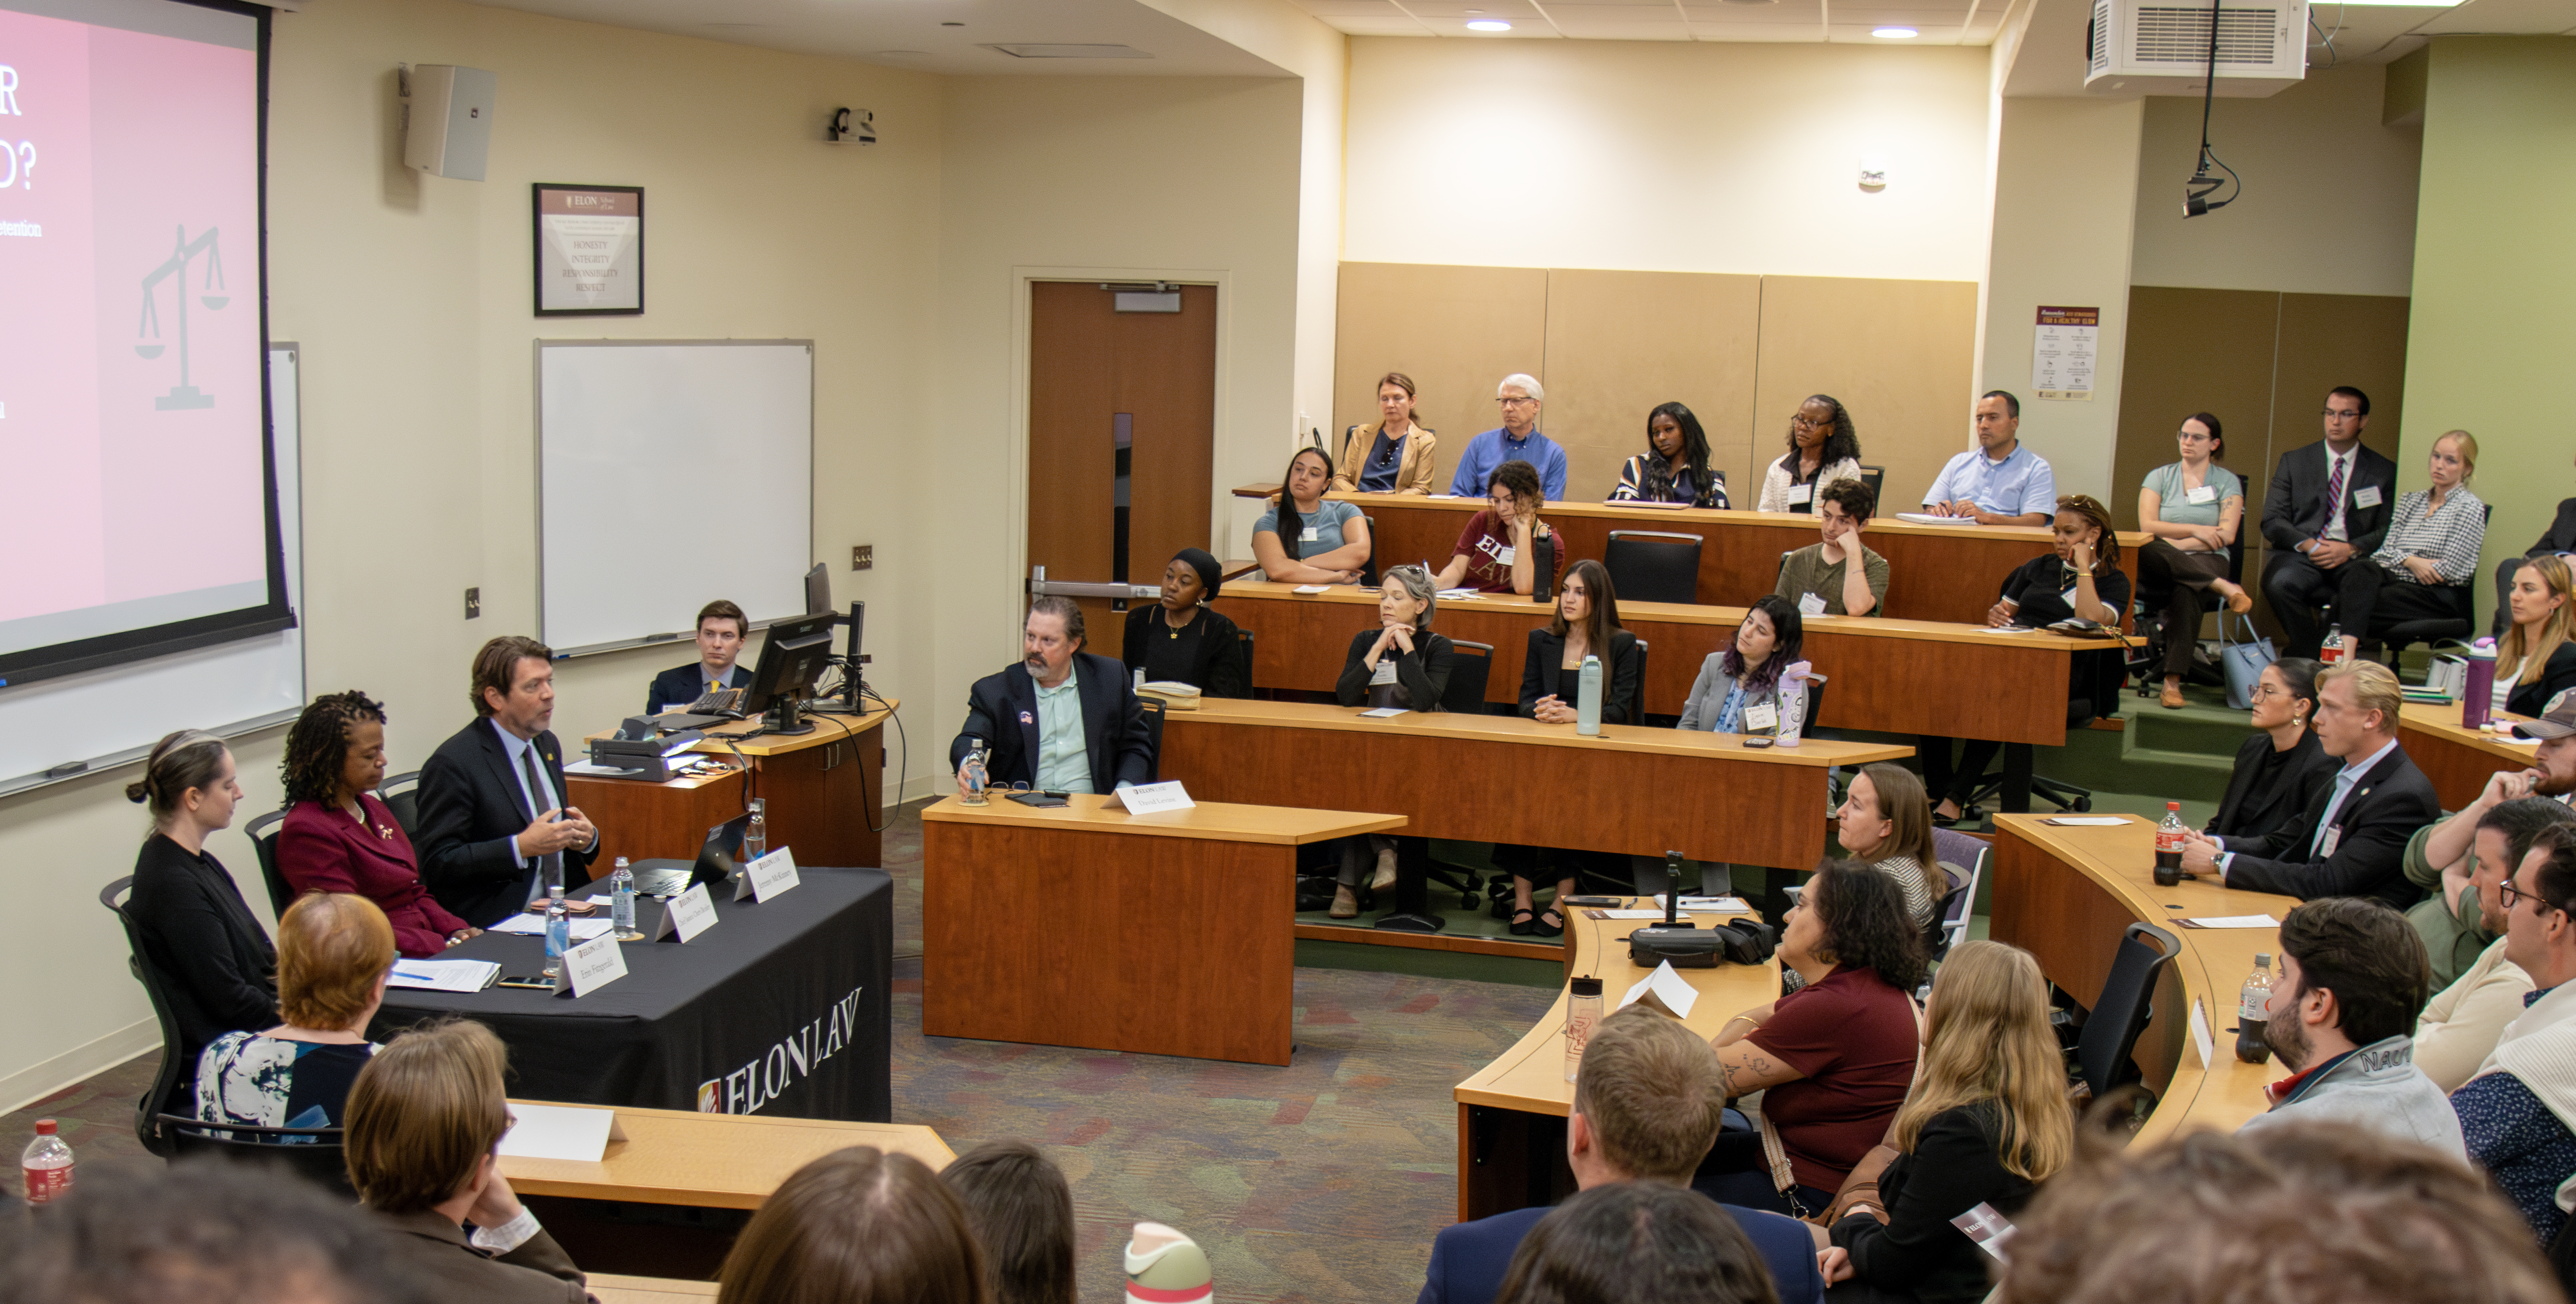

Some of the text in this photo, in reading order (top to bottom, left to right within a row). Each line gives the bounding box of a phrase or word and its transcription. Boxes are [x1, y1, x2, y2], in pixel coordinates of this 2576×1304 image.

[575, 196, 597, 205] ELON
[574, 241, 608, 249] HONESTY
[572, 255, 609, 264] INTEGRITY
[563, 269, 618, 278] RESPONSIBILITY
[576, 283, 605, 292] RESPECT
[582, 946, 596, 956] ELON
[581, 968, 592, 979] Erin
[726, 986, 862, 1115] ELON LAW
